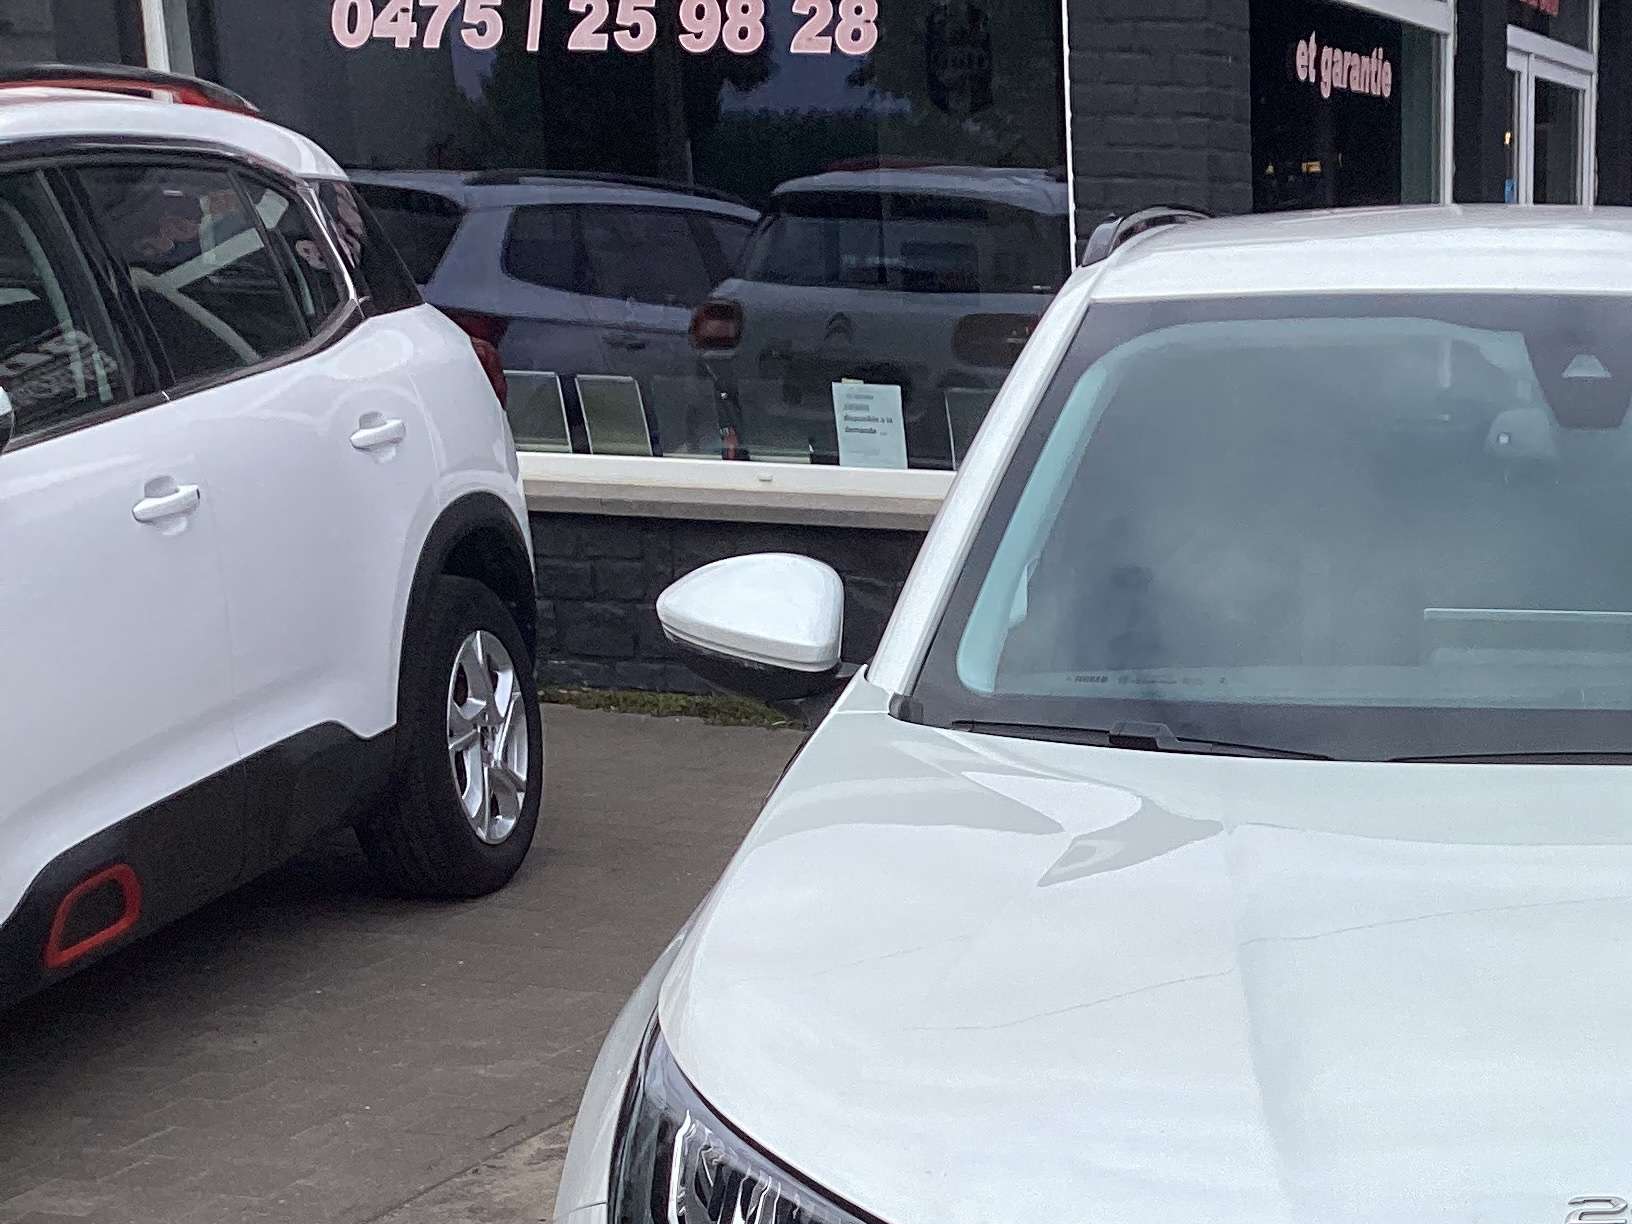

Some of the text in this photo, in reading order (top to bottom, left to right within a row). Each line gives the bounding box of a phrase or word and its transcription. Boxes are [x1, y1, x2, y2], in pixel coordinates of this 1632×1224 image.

[331, 0, 504, 50] 0475
[567, 0, 657, 53] 25
[678, 0, 765, 54] 98
[790, 0, 880, 56] 28
[1296, 30, 1392, 98] et garantie
